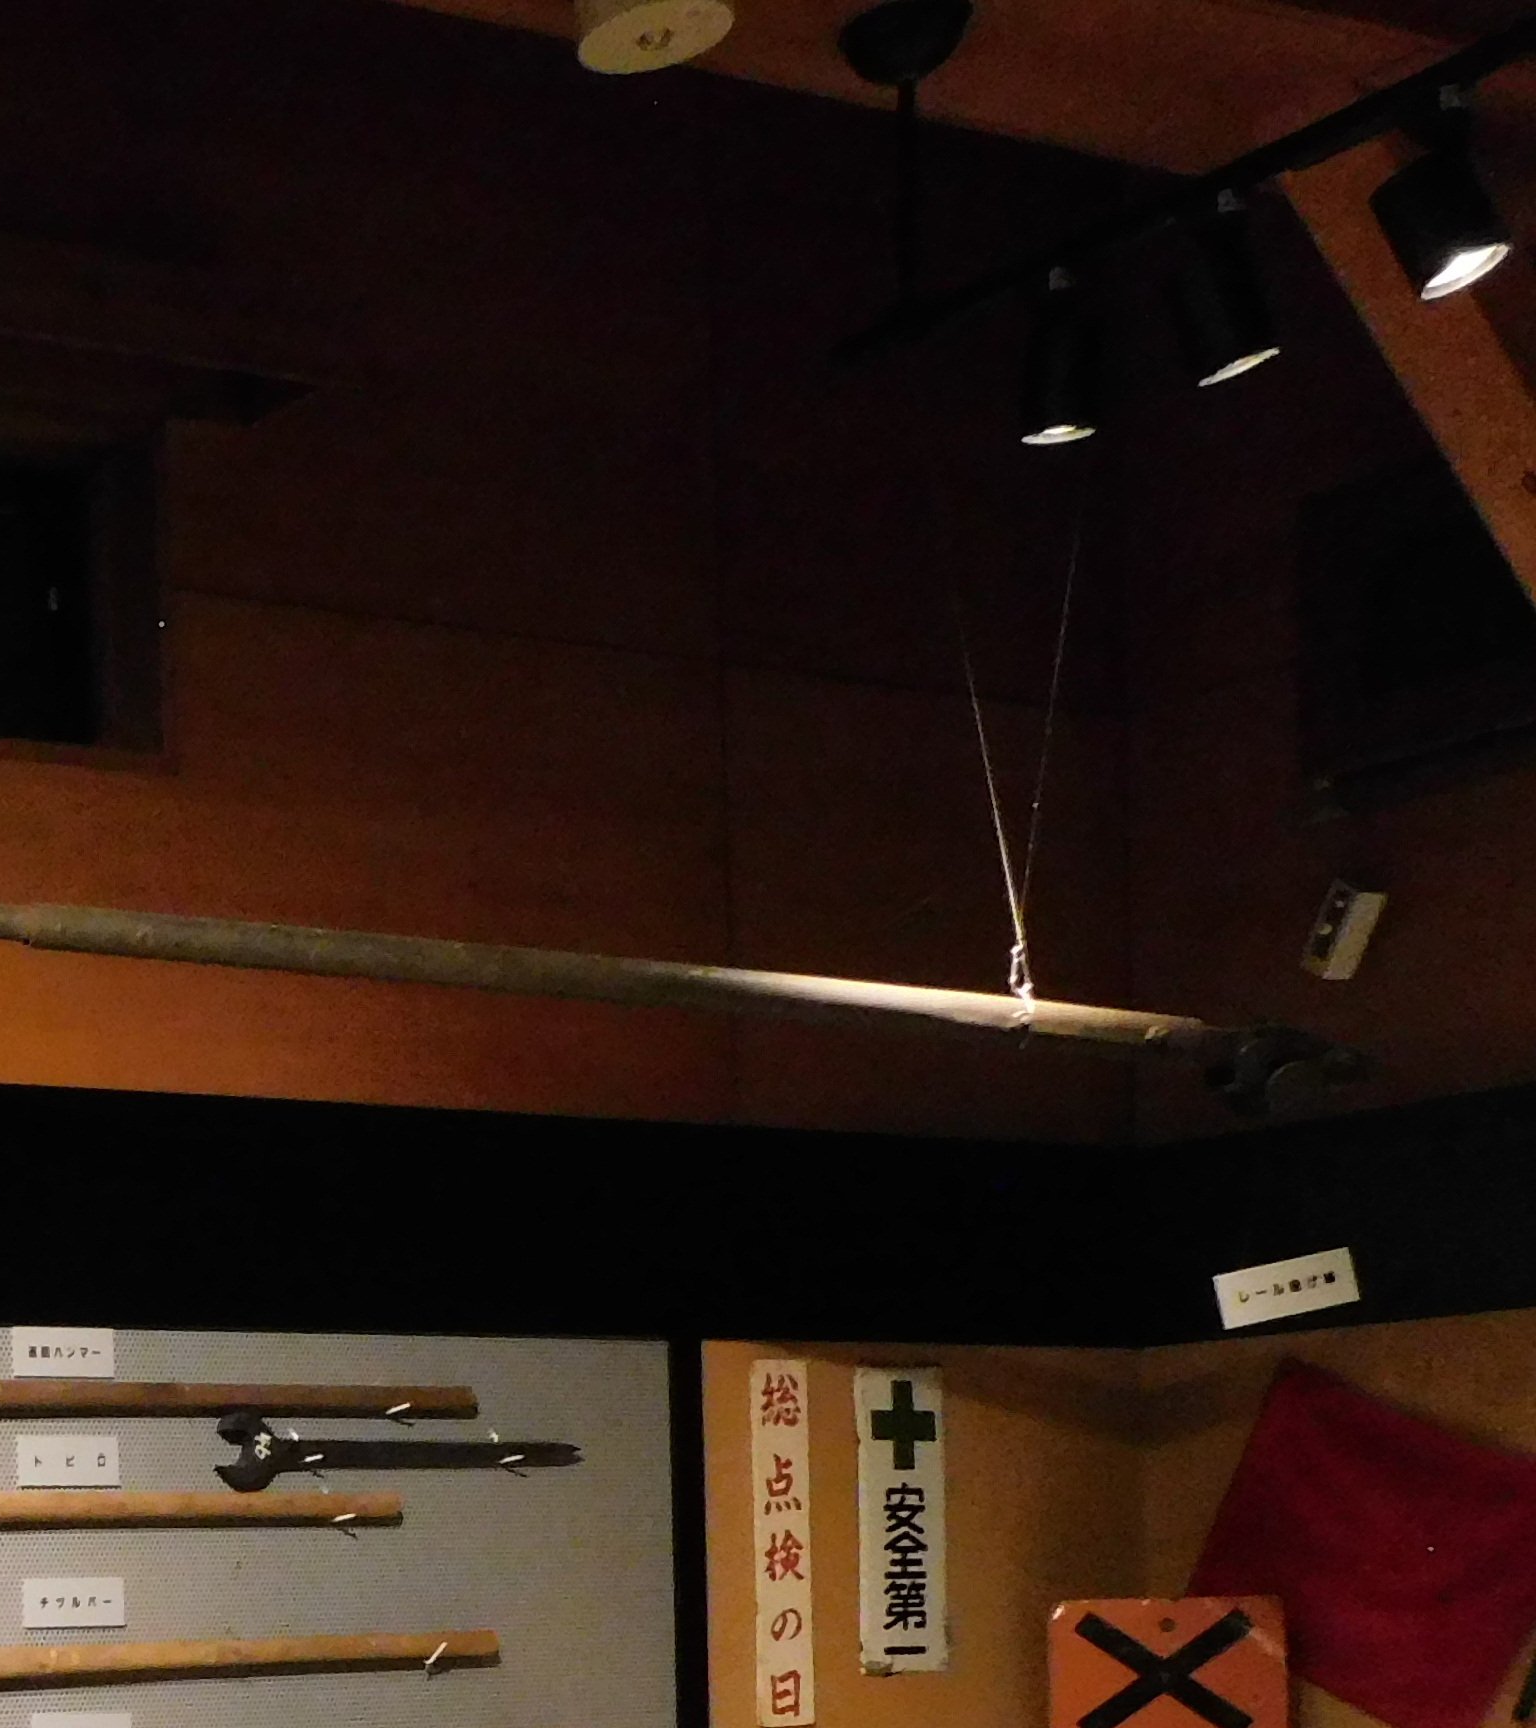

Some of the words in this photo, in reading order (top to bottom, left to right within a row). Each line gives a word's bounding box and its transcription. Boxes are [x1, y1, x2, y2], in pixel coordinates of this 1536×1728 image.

[760, 1371, 804, 1719] 総点検の日
[882, 1482, 929, 1657] 安全第一
